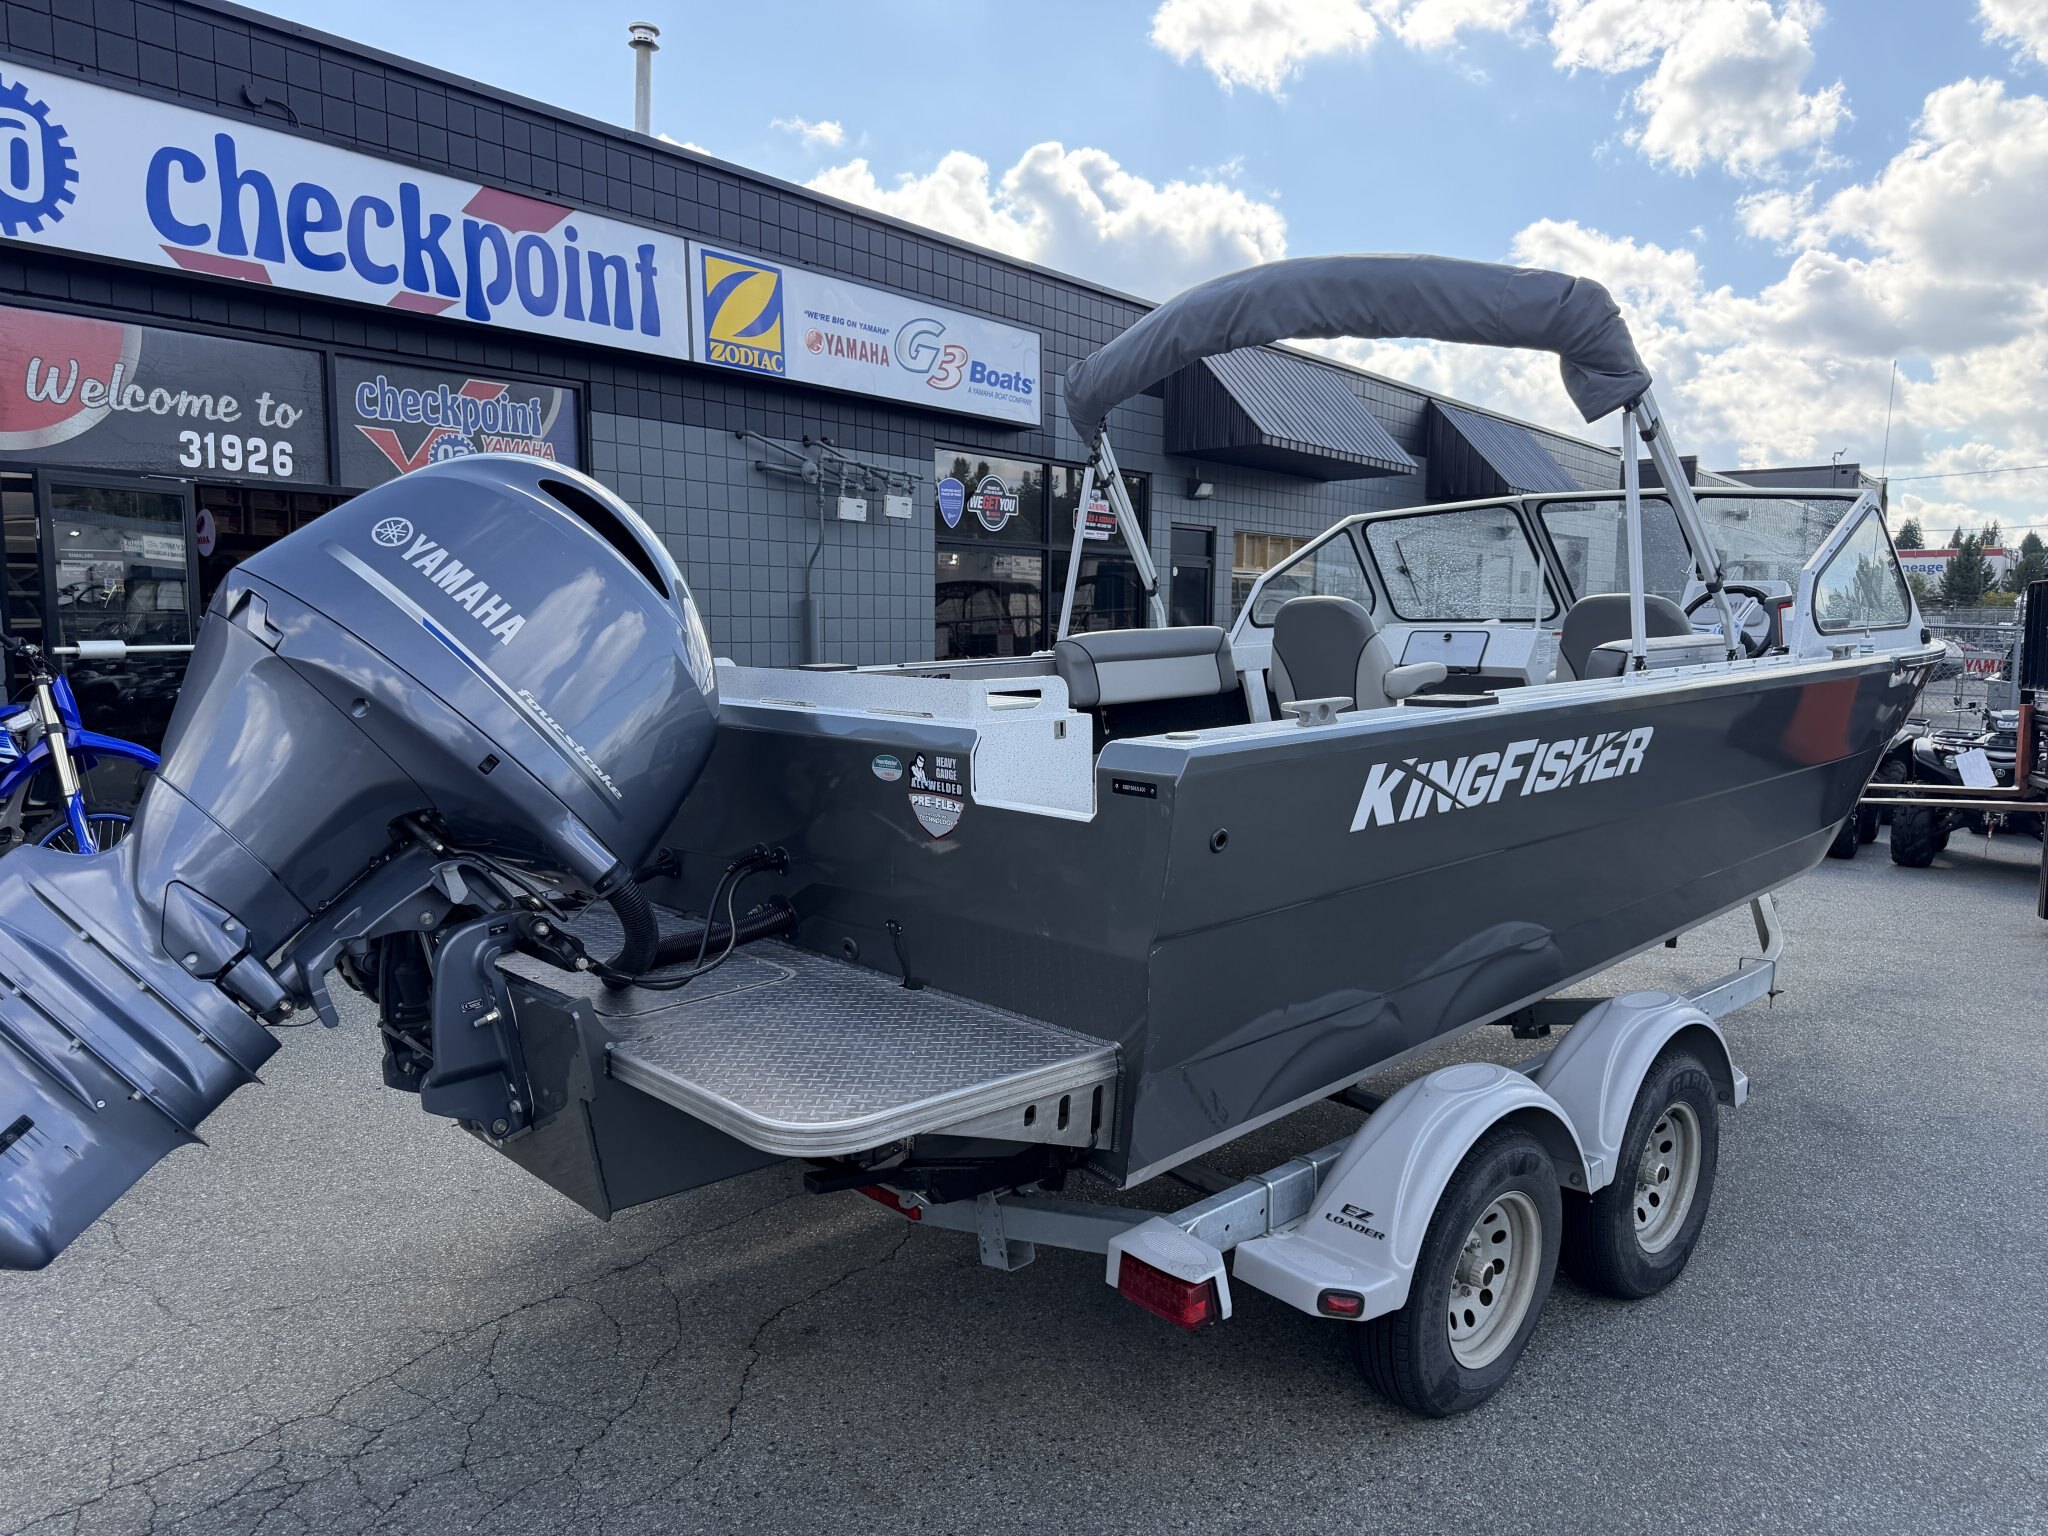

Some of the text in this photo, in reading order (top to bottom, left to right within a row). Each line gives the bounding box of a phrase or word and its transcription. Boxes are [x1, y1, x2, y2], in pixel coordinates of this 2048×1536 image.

[146, 133, 660, 337] checkpoint
[832, 316, 845, 325] BIG
[846, 320, 857, 328] ON
[709, 342, 784, 373] ZODIAC
[824, 332, 890, 367] YAMAHA
[25, 356, 303, 429] Welcome to
[356, 375, 543, 437] checkpoint
[973, 387, 994, 398] YAMAHA
[994, 391, 1009, 401] BOAT
[1008, 394, 1032, 406] COMPANY
[179, 431, 293, 477] 31926
[480, 435, 556, 461] YAMAHA
[1903, 563, 1944, 575] neage
[401, 533, 527, 646] YAMAHA
[517, 688, 623, 800] fourstroke
[936, 756, 957, 769] HEAVY
[936, 768, 957, 781] GAUGE
[927, 780, 963, 795] WELDED
[1350, 726, 1654, 833] KINGFISHER
[911, 795, 961, 813] PRE-FLEX
[919, 814, 954, 827] TECHNOLOGY
[1325, 1212, 1385, 1240] LOADER
[1340, 1203, 1374, 1223] EZ
